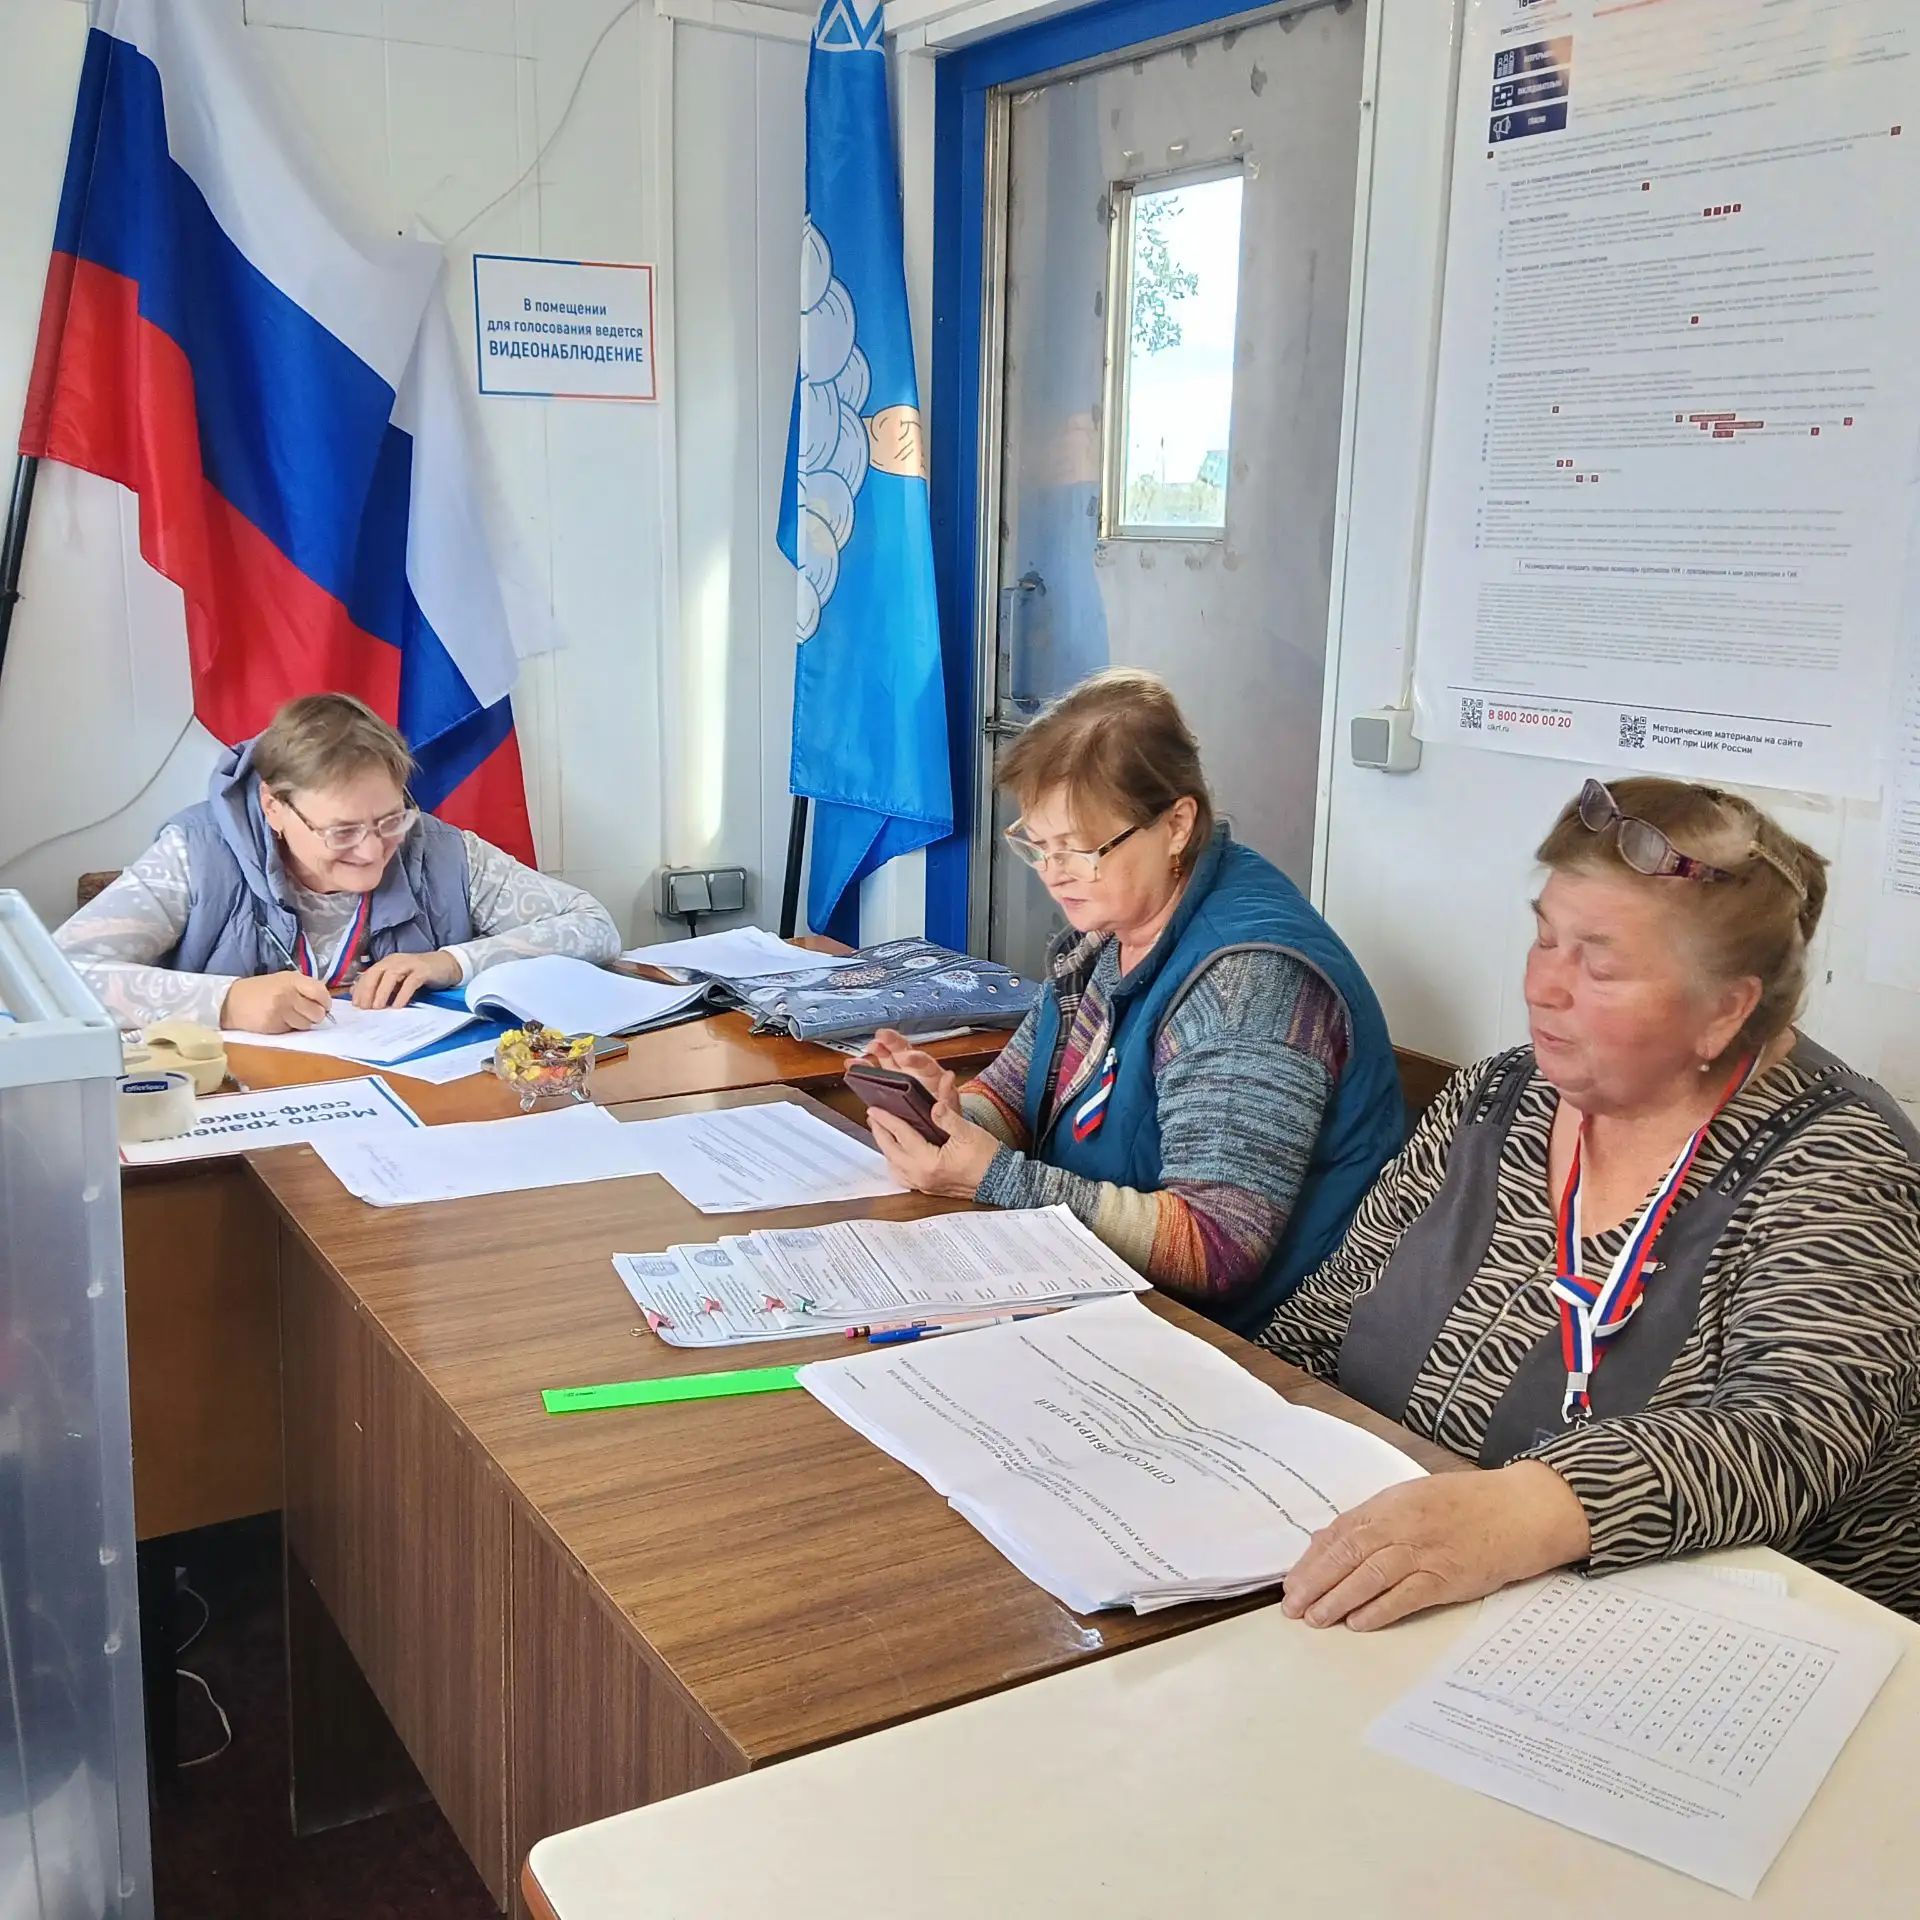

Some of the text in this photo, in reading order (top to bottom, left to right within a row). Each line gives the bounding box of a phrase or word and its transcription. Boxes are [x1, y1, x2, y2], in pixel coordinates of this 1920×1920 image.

[523, 298, 607, 316] В помещении
[487, 319, 643, 338] для голосования ведется
[489, 340, 644, 363] ВИДЕОНАБЛЮДЕНИЕ
[1488, 709, 1572, 729] 8 800 200 00 20
[1652, 722, 1804, 748] Методические материалы на сайте
[1652, 734, 1753, 754] РЦОИТ при ЦИК России
[194, 1100, 352, 1126] сейф-паке
[140, 1107, 377, 1143] Место хранен
[1118, 1452, 1178, 1485] СПИСОК
